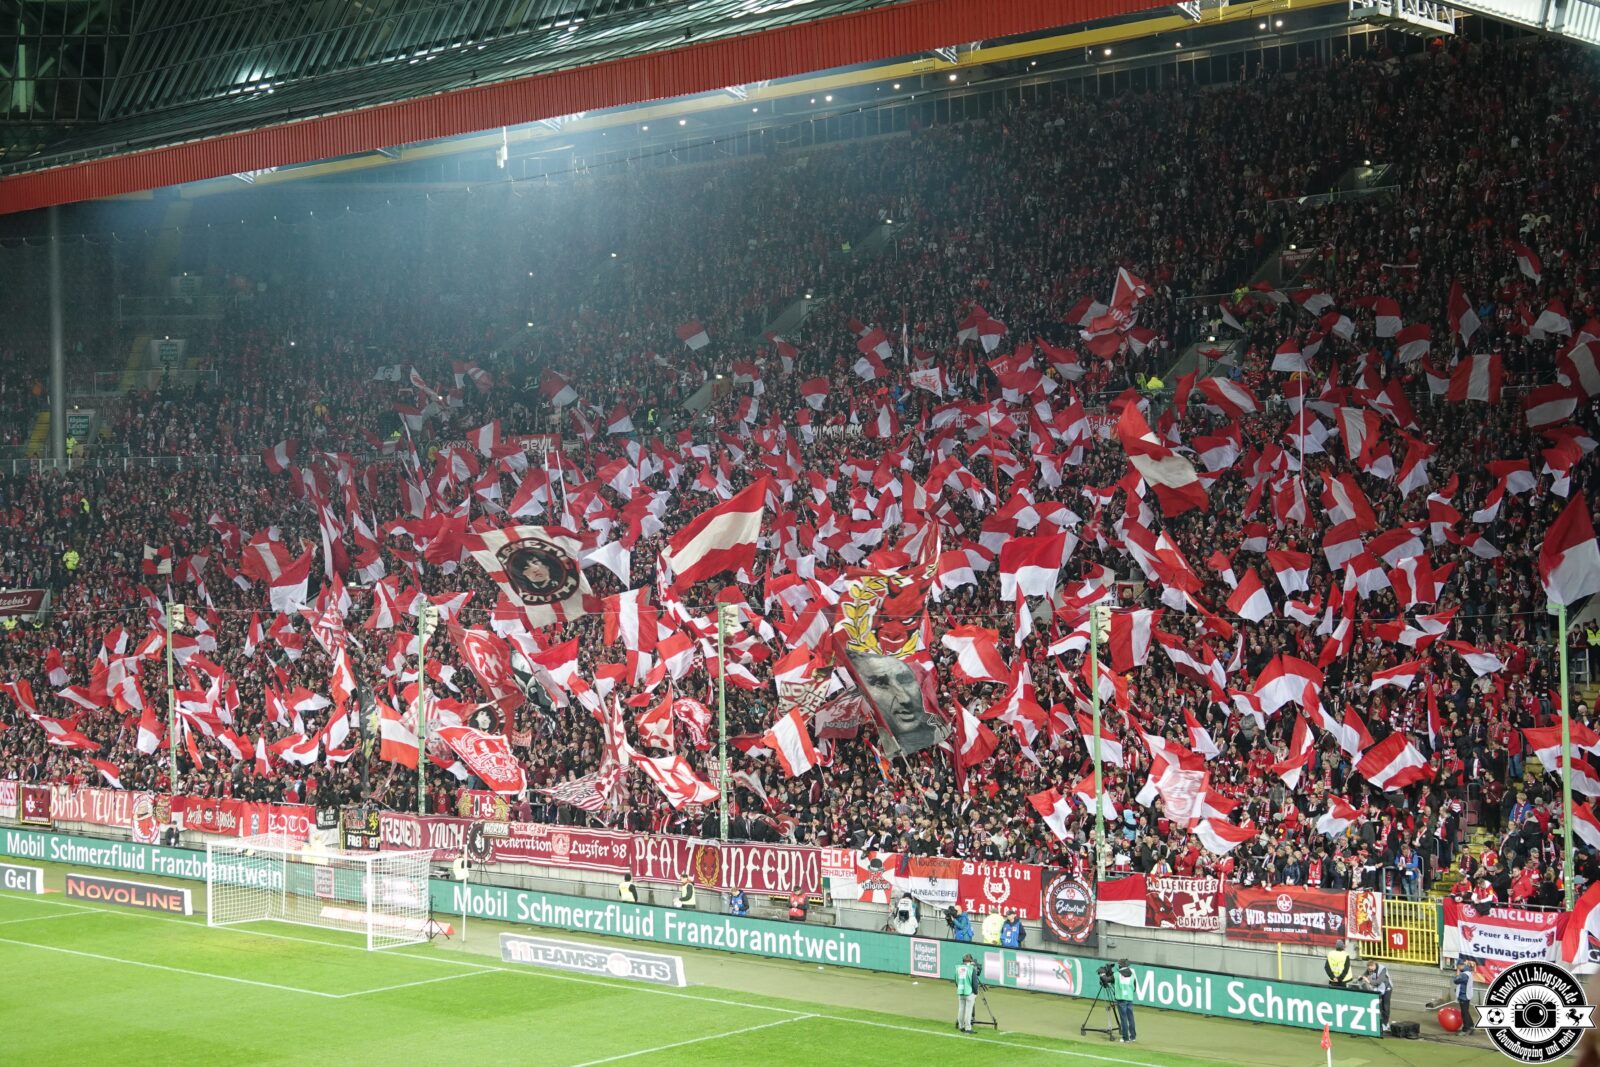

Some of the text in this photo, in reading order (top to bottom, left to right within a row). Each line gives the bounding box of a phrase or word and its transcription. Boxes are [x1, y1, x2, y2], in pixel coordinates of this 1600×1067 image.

[90, 788, 132, 825] TEUFEL
[427, 822, 465, 849] YOUTH
[495, 836, 552, 853] Generation
[569, 839, 609, 859] Luzifer
[610, 840, 627, 859] '98
[7, 831, 45, 858] Mobil
[50, 836, 145, 870] Schmerzfluid
[151, 848, 284, 892] Franzbranntwein
[634, 837, 820, 893] PFALZ INFERNO
[962, 861, 1031, 881] Division
[4, 871, 32, 891] Gel
[453, 885, 862, 965] Mobil Schmerzfluid Franzbranntwein
[1245, 908, 1326, 930] WIR SIND BETZE
[1487, 909, 1544, 924] ANCLUB
[1479, 929, 1501, 939] Feuer
[914, 942, 937, 954] Allgäuer
[914, 952, 937, 965] Latschen
[917, 961, 934, 972] Kiefer
[1131, 967, 1380, 1033] Mobil Schmerzf
